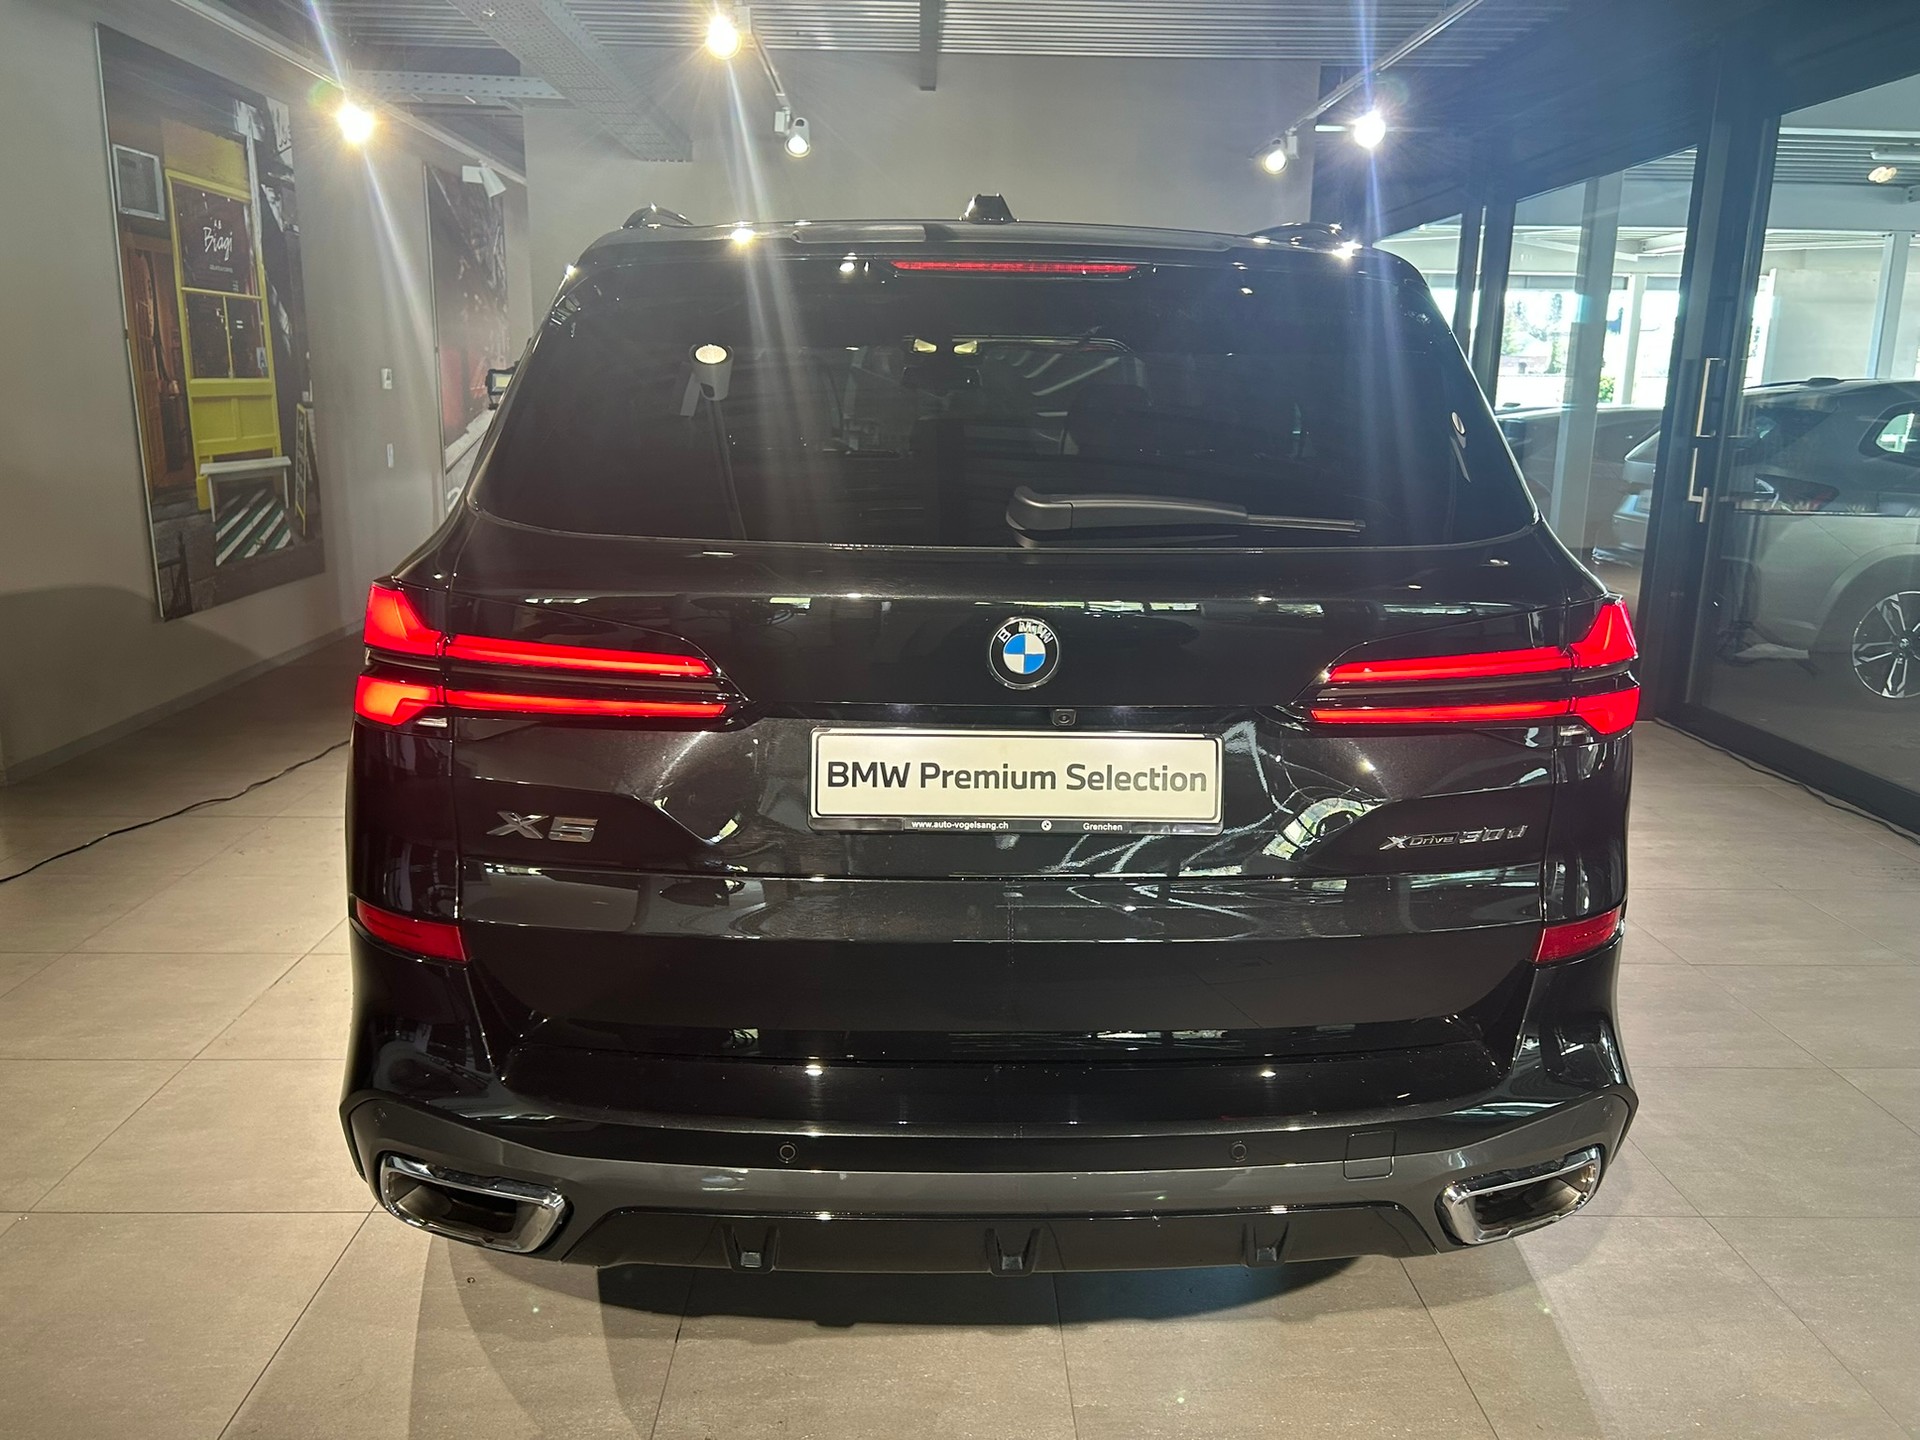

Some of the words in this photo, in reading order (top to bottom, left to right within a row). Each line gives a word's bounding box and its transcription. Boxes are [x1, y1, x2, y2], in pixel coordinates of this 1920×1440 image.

[827, 761, 911, 788] BMW
[920, 762, 1056, 790] Premium
[1066, 763, 1207, 792] Selection
[486, 811, 599, 842] X5
[911, 820, 1009, 831] www.auto-vogelsang.ch
[1082, 822, 1123, 831] Grenchen
